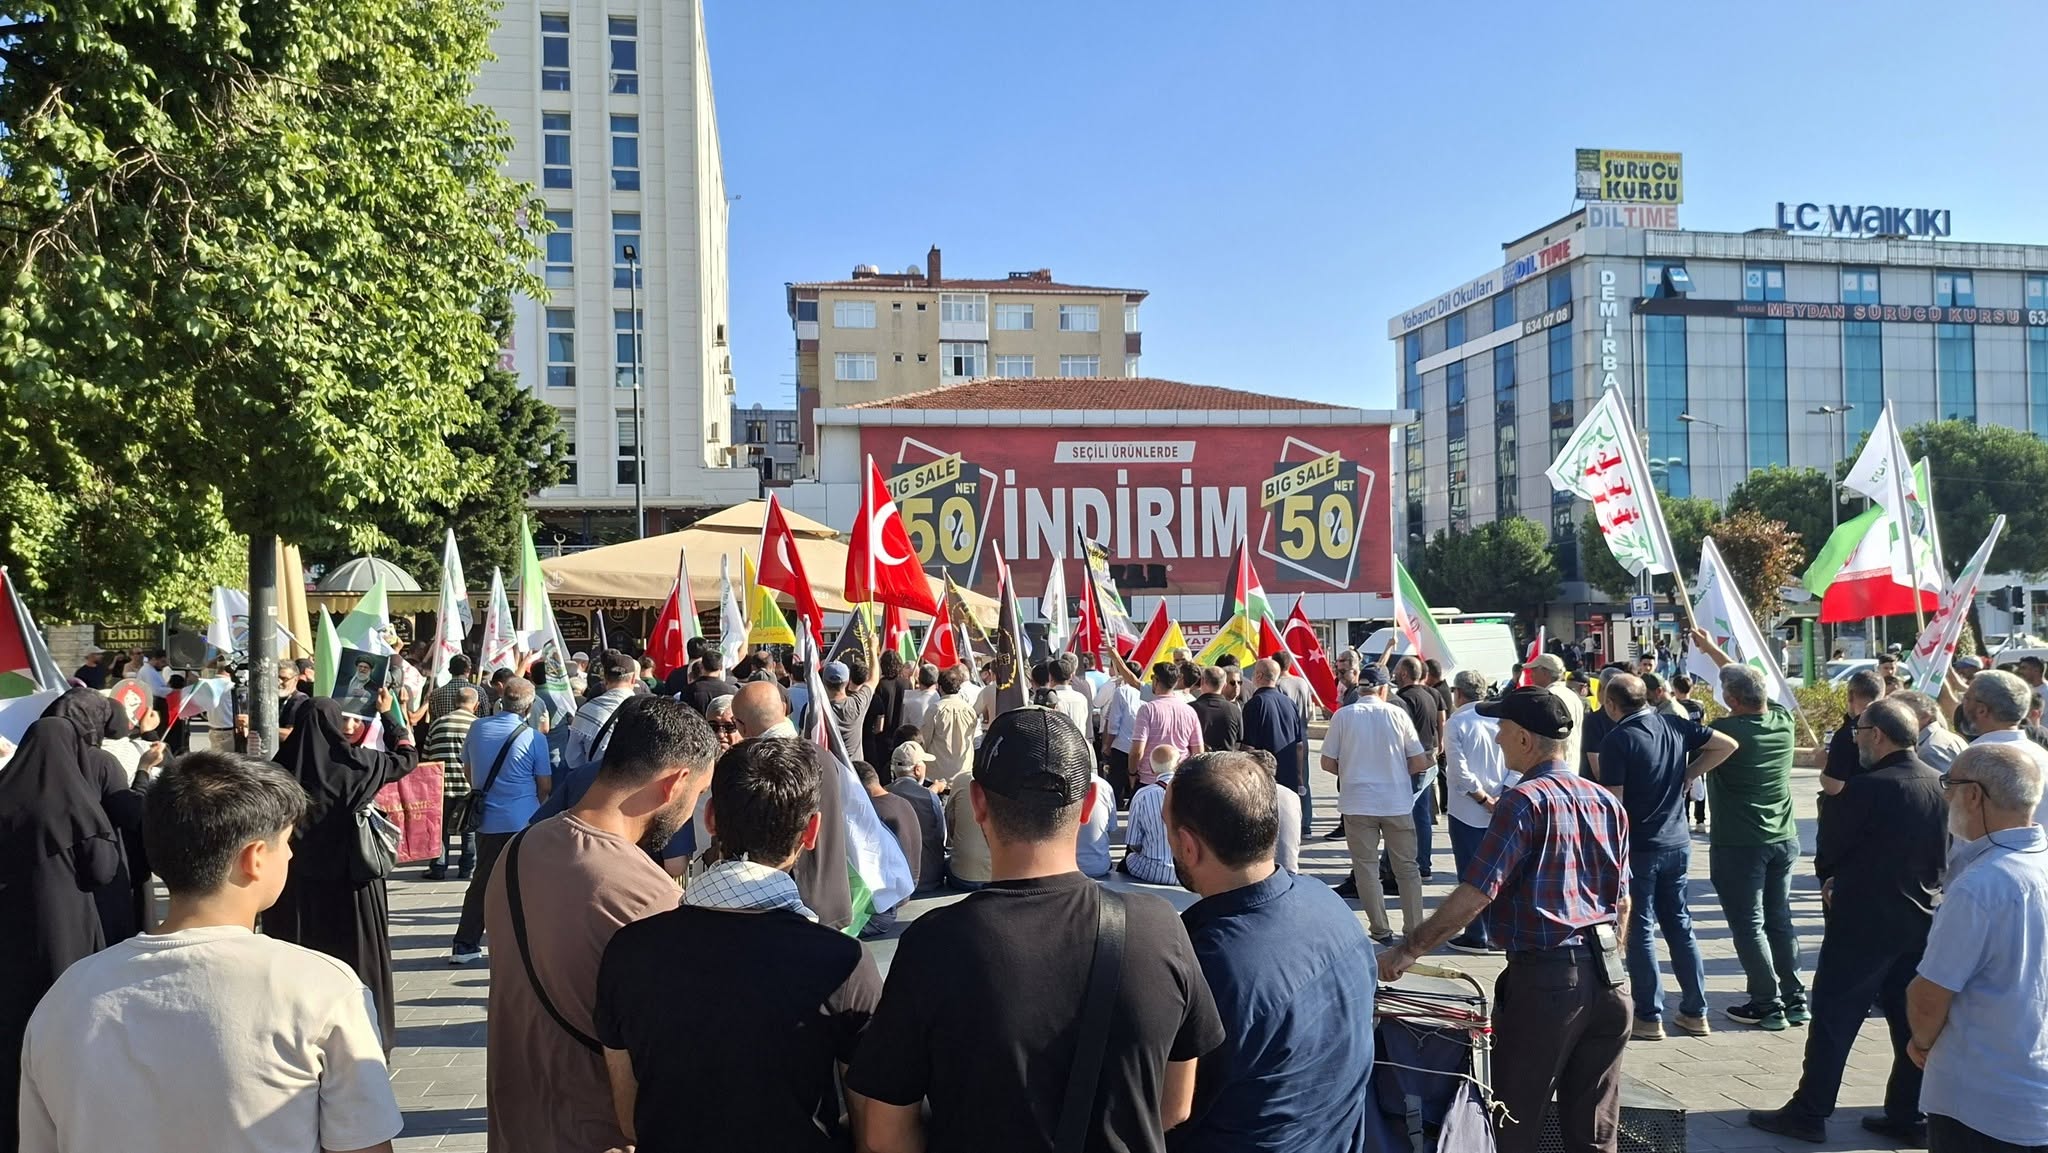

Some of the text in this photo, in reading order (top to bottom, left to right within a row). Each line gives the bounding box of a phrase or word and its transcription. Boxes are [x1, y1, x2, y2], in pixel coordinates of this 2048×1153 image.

[1605, 160, 1679, 180] SÜRÜCÜ
[1606, 181, 1677, 201] KURSU
[1777, 202, 1820, 231] LC
[1539, 238, 1571, 268] TIME
[1402, 280, 1493, 330] Yabancı Dil Okulları
[1767, 303, 1845, 319] MEYDAN
[1854, 303, 1942, 321] SÜRÜCÜ
[1948, 307, 2020, 324] KURSU
[2028, 310, 2048, 326] 63
[1525, 318, 1542, 334] 634
[1543, 313, 1554, 328] 07
[1599, 270, 1618, 392] DEMİRBA
[1072, 444, 1179, 461] SEÇİLİ ÜRÜNLERDE
[915, 459, 956, 489] SALE
[1265, 457, 1335, 500] BIG SALE
[955, 482, 977, 494] NET
[1334, 480, 1355, 492] NET
[1003, 468, 1248, 560] İNDİRİM
[550, 599, 586, 608] ERKEZ
